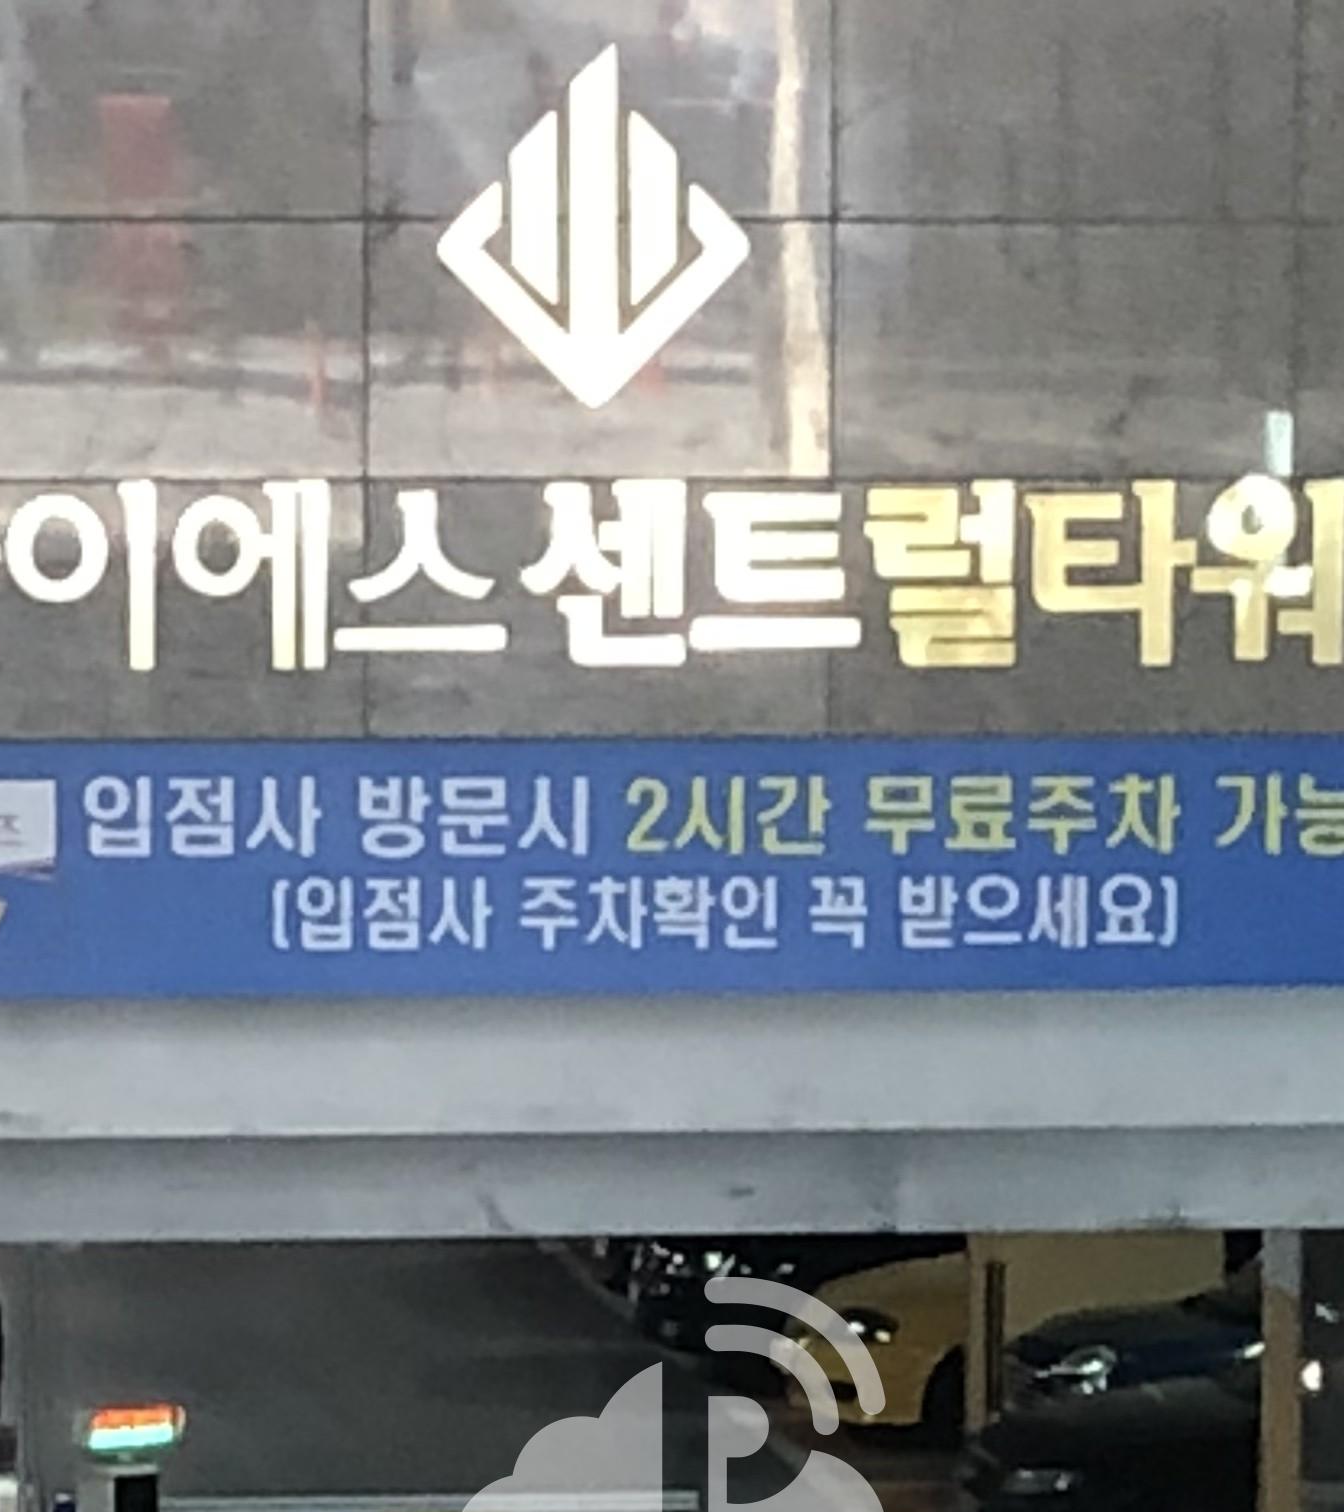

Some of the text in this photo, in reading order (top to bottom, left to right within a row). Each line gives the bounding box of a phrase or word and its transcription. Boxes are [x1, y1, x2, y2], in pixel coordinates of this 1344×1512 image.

[83, 775, 322, 858] 입점사
[358, 775, 590, 859] 방문시
[625, 774, 833, 857] 2시간
[864, 772, 1182, 856] 무료주차
[519, 875, 778, 951] 주차확인
[808, 875, 868, 950] 꼭
